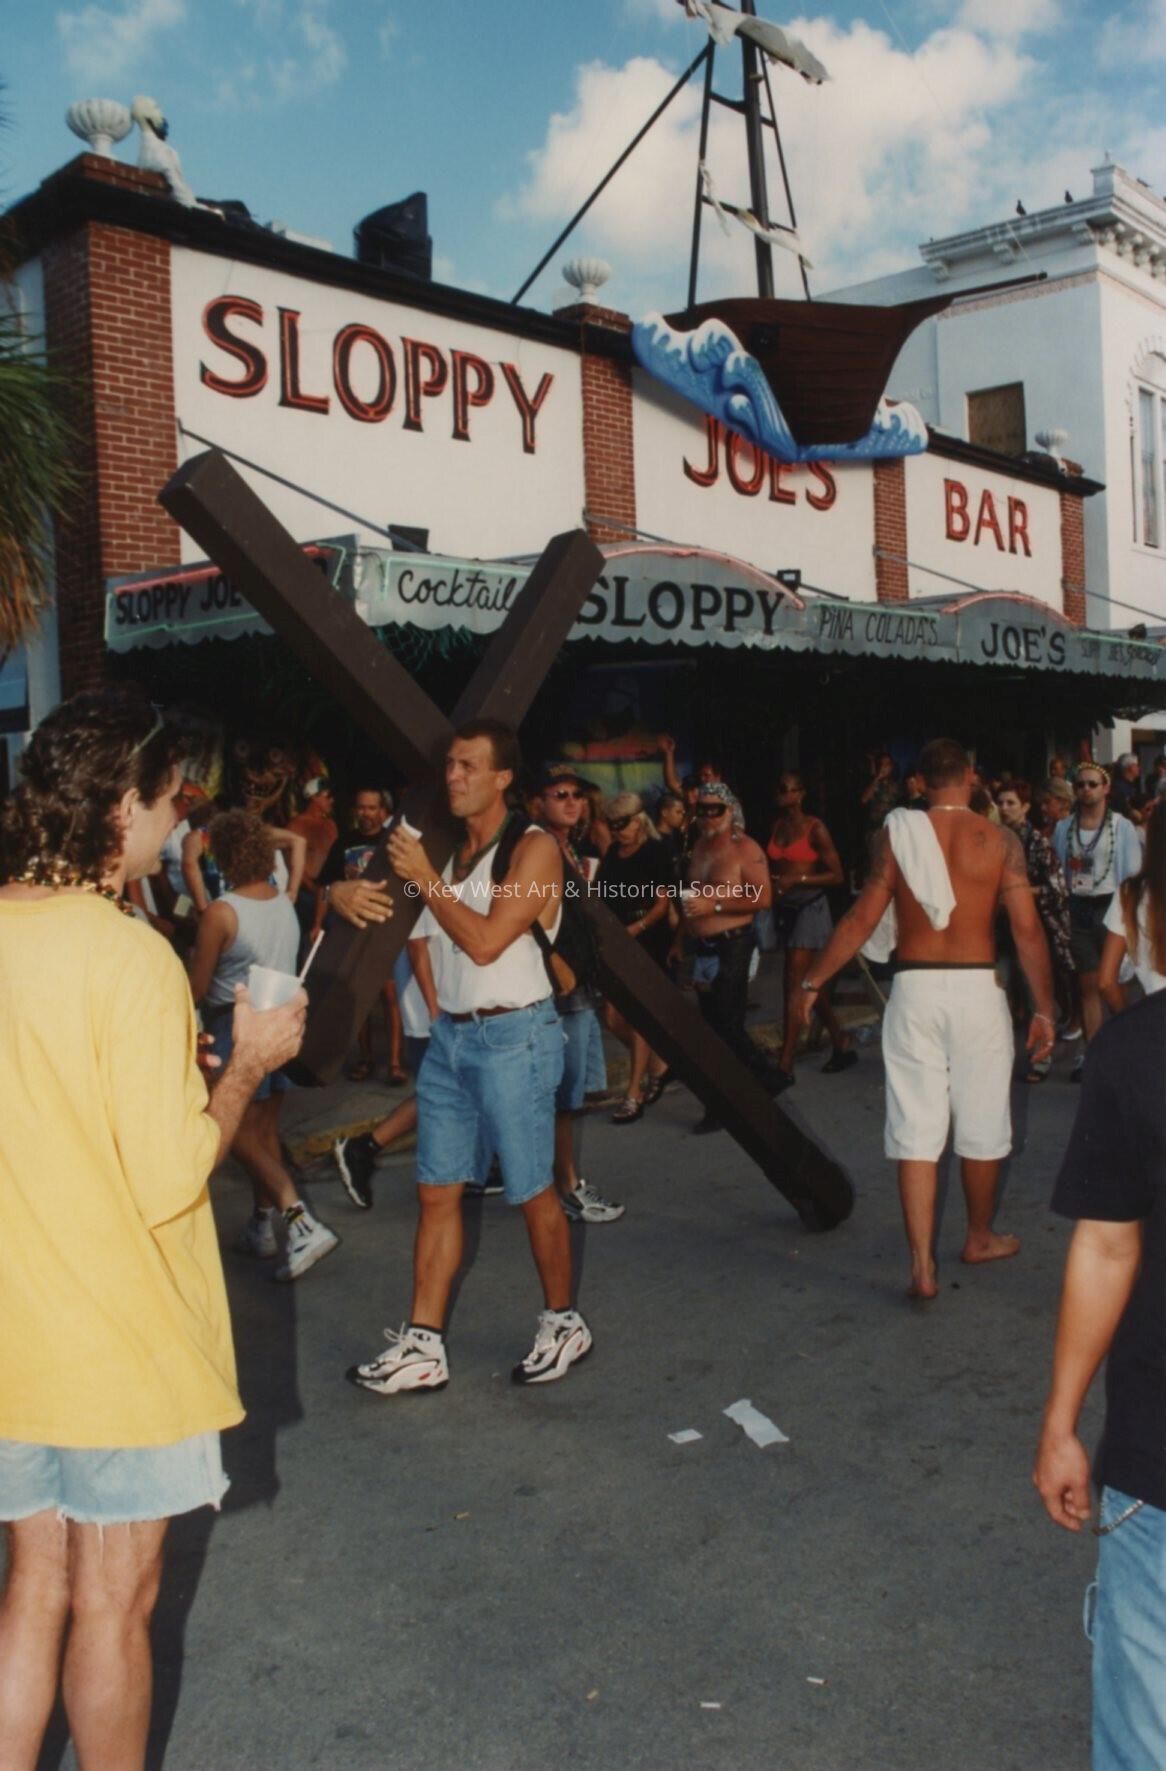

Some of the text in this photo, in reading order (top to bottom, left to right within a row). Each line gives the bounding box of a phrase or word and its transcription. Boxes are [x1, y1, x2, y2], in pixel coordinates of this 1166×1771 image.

[200, 295, 554, 455] SLOPPY
[943, 478, 1032, 558] BAR
[115, 582, 192, 625] SLOPPY
[575, 575, 786, 636] SLOPPY
[980, 622, 1066, 666] JOE'S
